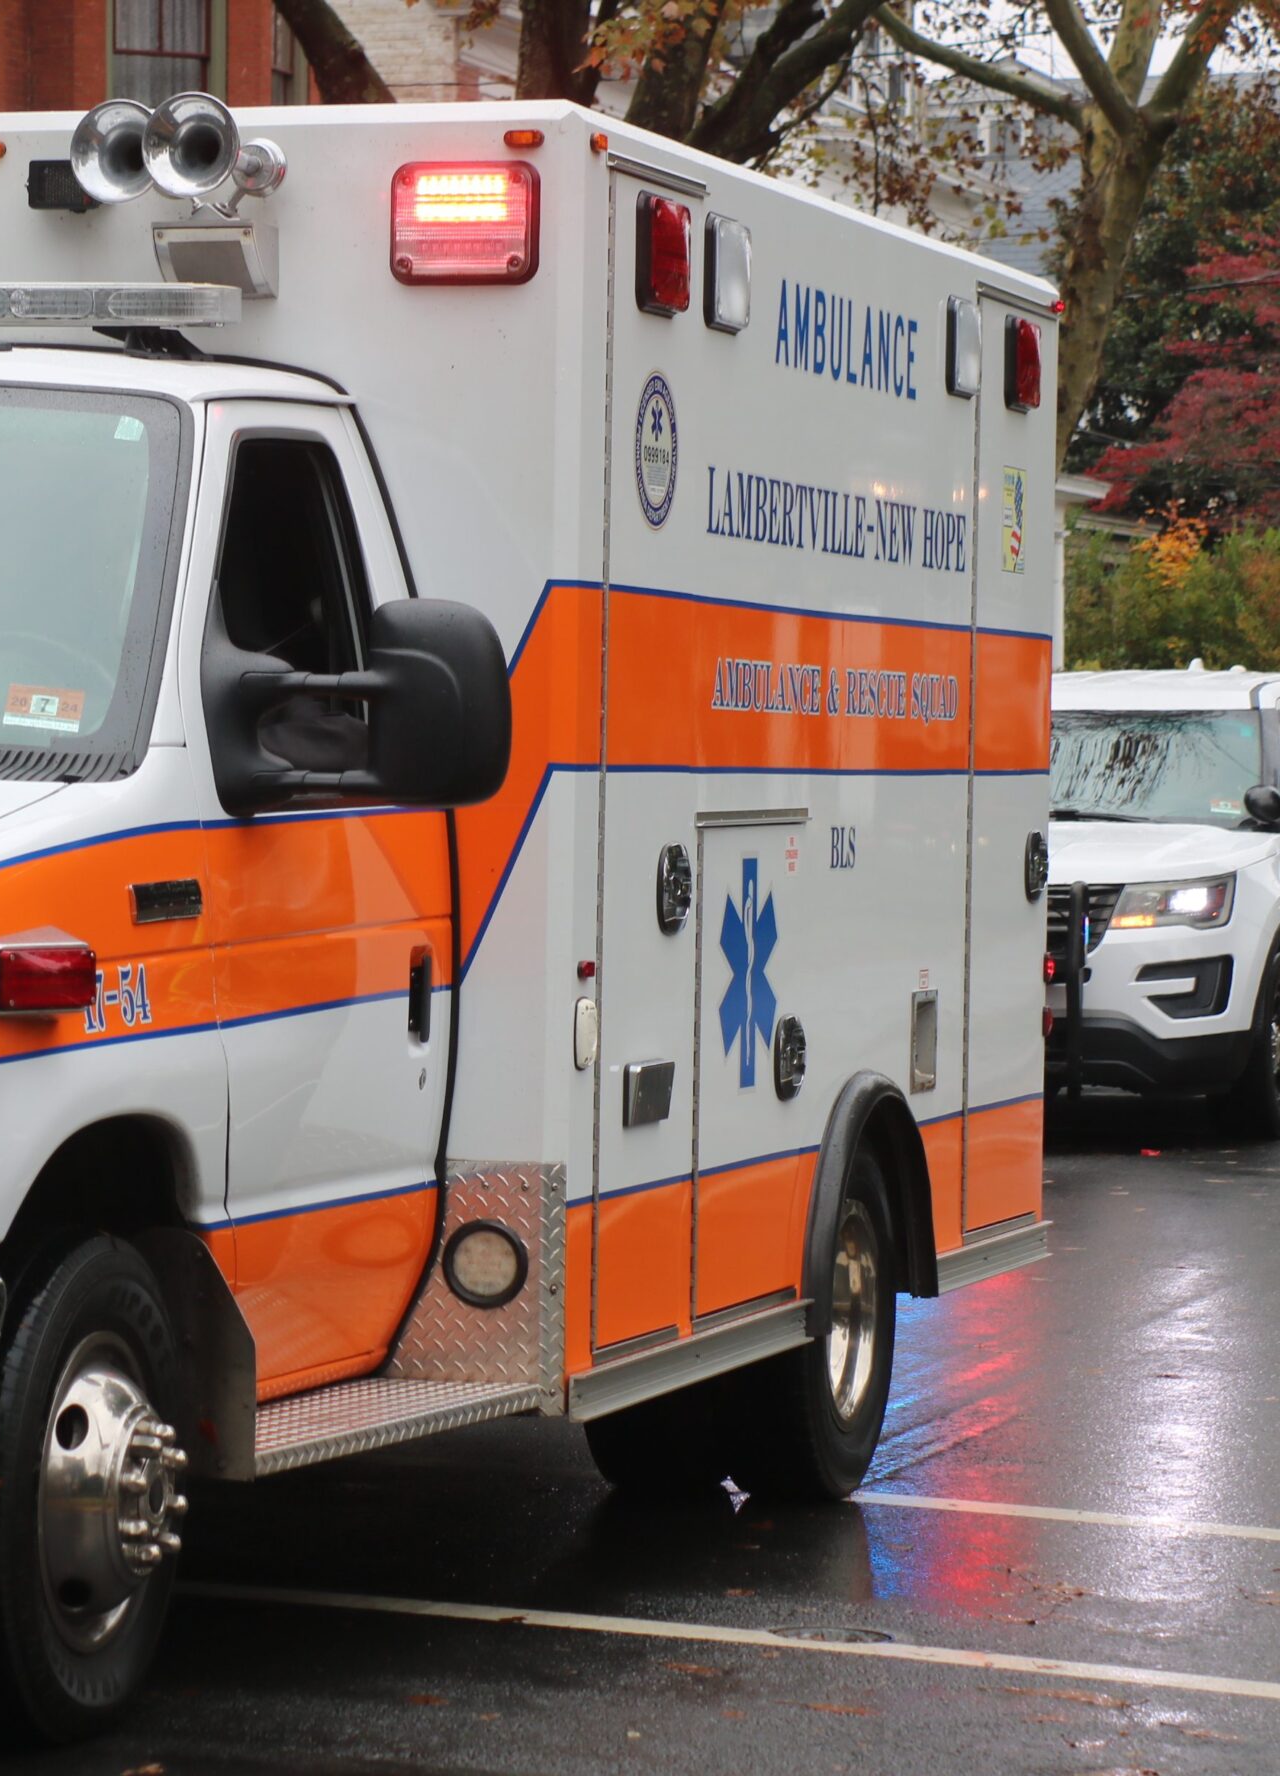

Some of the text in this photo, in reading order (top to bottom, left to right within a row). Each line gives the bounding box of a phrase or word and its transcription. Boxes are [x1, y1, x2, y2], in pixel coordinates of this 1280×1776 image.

[775, 279, 918, 400] AMBULANCE
[706, 466, 966, 573] LAMBERTVILLE-NEW HOPE
[39, 698, 50, 712] 7
[712, 657, 959, 726] AMBULANCE & RESCUE SQUAD
[829, 825, 856, 869] BLS
